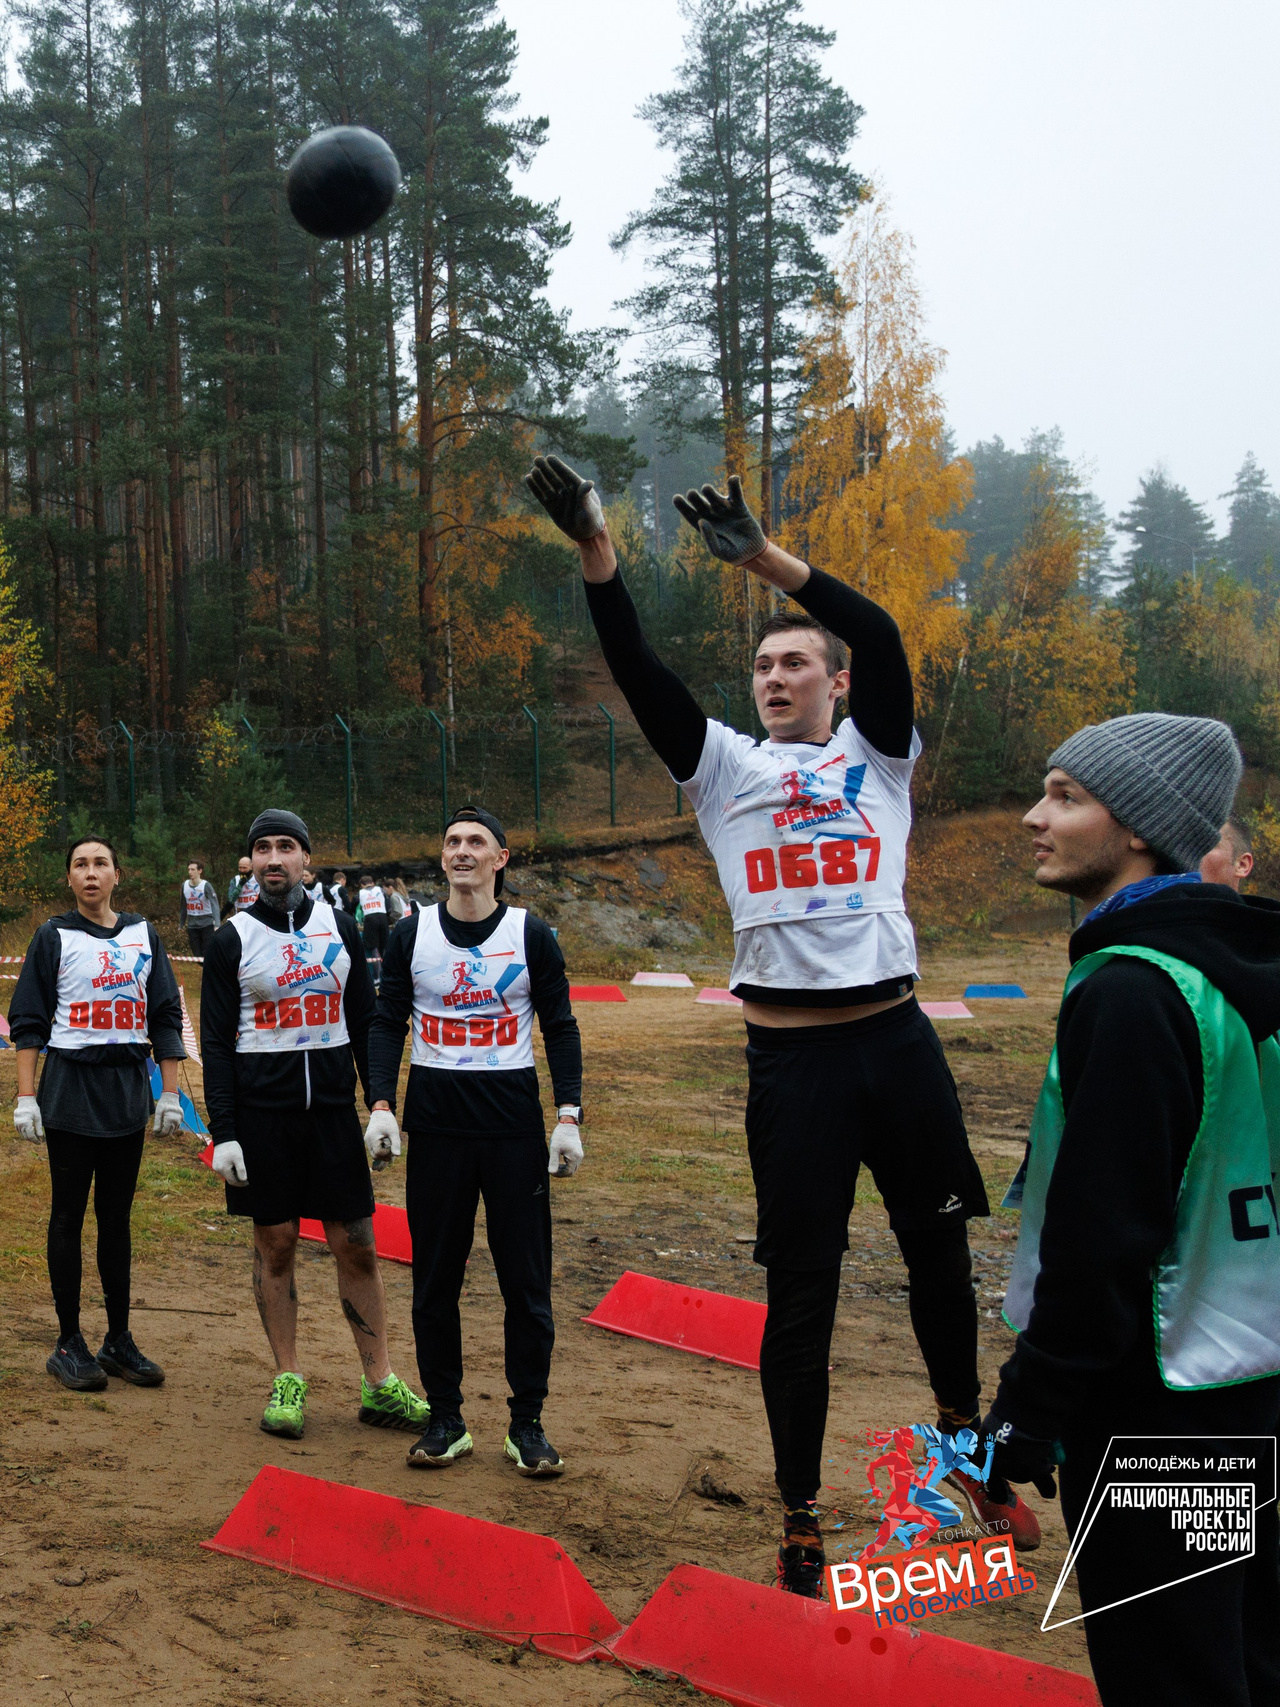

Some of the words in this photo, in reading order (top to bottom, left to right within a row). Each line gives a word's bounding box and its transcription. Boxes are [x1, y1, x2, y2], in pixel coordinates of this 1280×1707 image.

[772, 798, 843, 828] ВРЕМЯ
[790, 808, 851, 832] ПОБЕЖДАТЬ
[744, 836, 881, 894] 0687
[91, 972, 133, 989] ВРЕМЯ
[276, 965, 323, 987] ВРЕМЯ
[289, 972, 328, 989] ПОБЕЖДАТЬ
[441, 989, 493, 1006] ВРЕМЯ
[454, 998, 497, 1011] ПОБЕЖДАТЬ
[69, 1000, 146, 1030] 0689
[254, 993, 342, 1030] 0688
[420, 1014, 520, 1047] 0690
